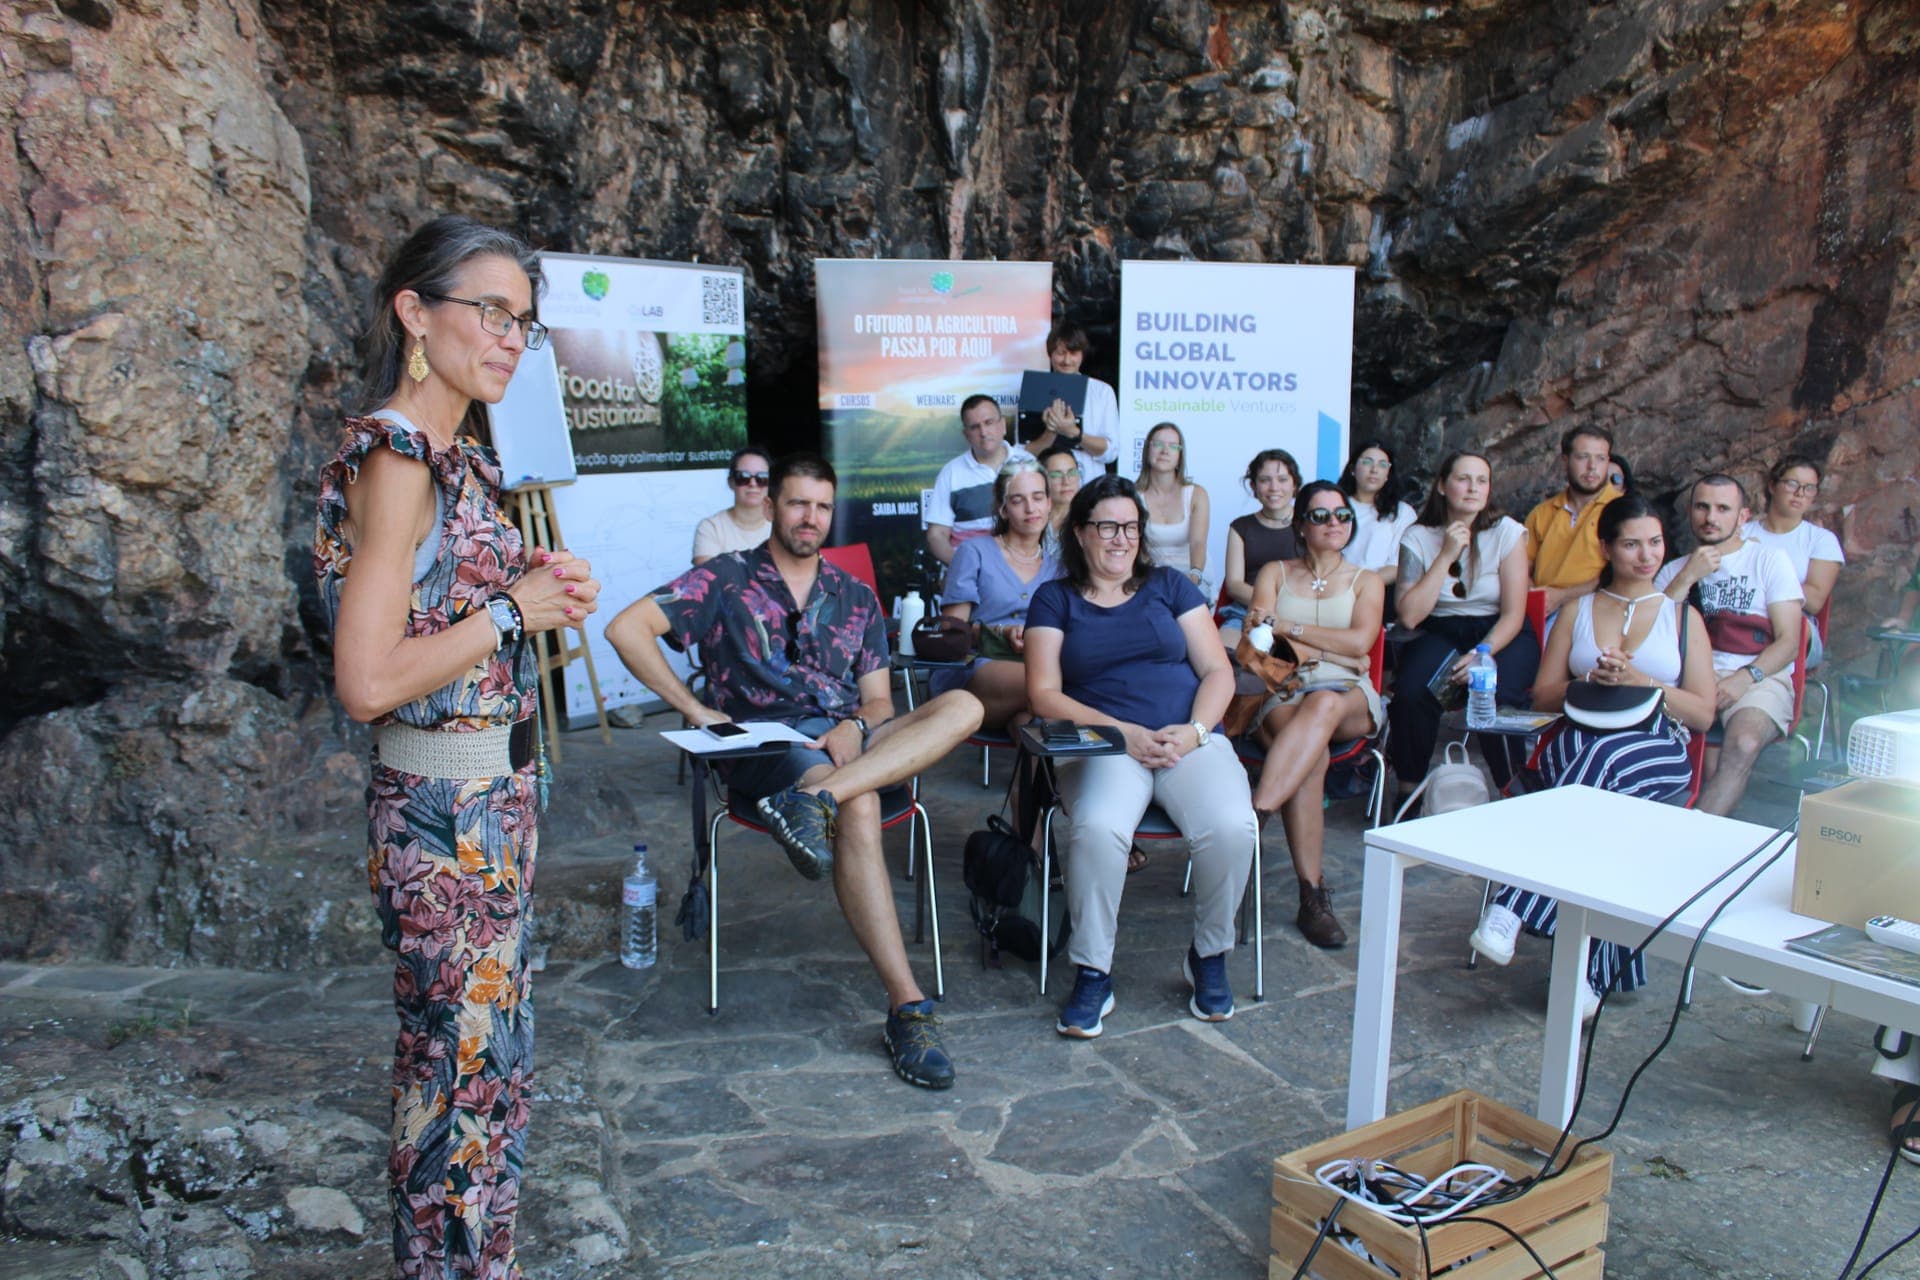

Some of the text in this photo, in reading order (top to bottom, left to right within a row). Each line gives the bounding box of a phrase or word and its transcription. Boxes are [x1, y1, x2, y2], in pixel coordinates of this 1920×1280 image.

[854, 314, 1017, 335] O FUTURO DA AGRICULTURA
[1136, 312, 1257, 333] BUILDING
[881, 337, 992, 358] PASSA POR AQUI
[1135, 341, 1236, 361] GLOBAL
[558, 366, 613, 400] food
[1135, 370, 1298, 391] INNOVATORS
[840, 394, 871, 407] CURSOS
[916, 393, 956, 407] WEBINARS
[1134, 398, 1297, 413] Sustainable Ventures
[897, 501, 919, 515] MAIS
[1820, 826, 1862, 844] EPSON
